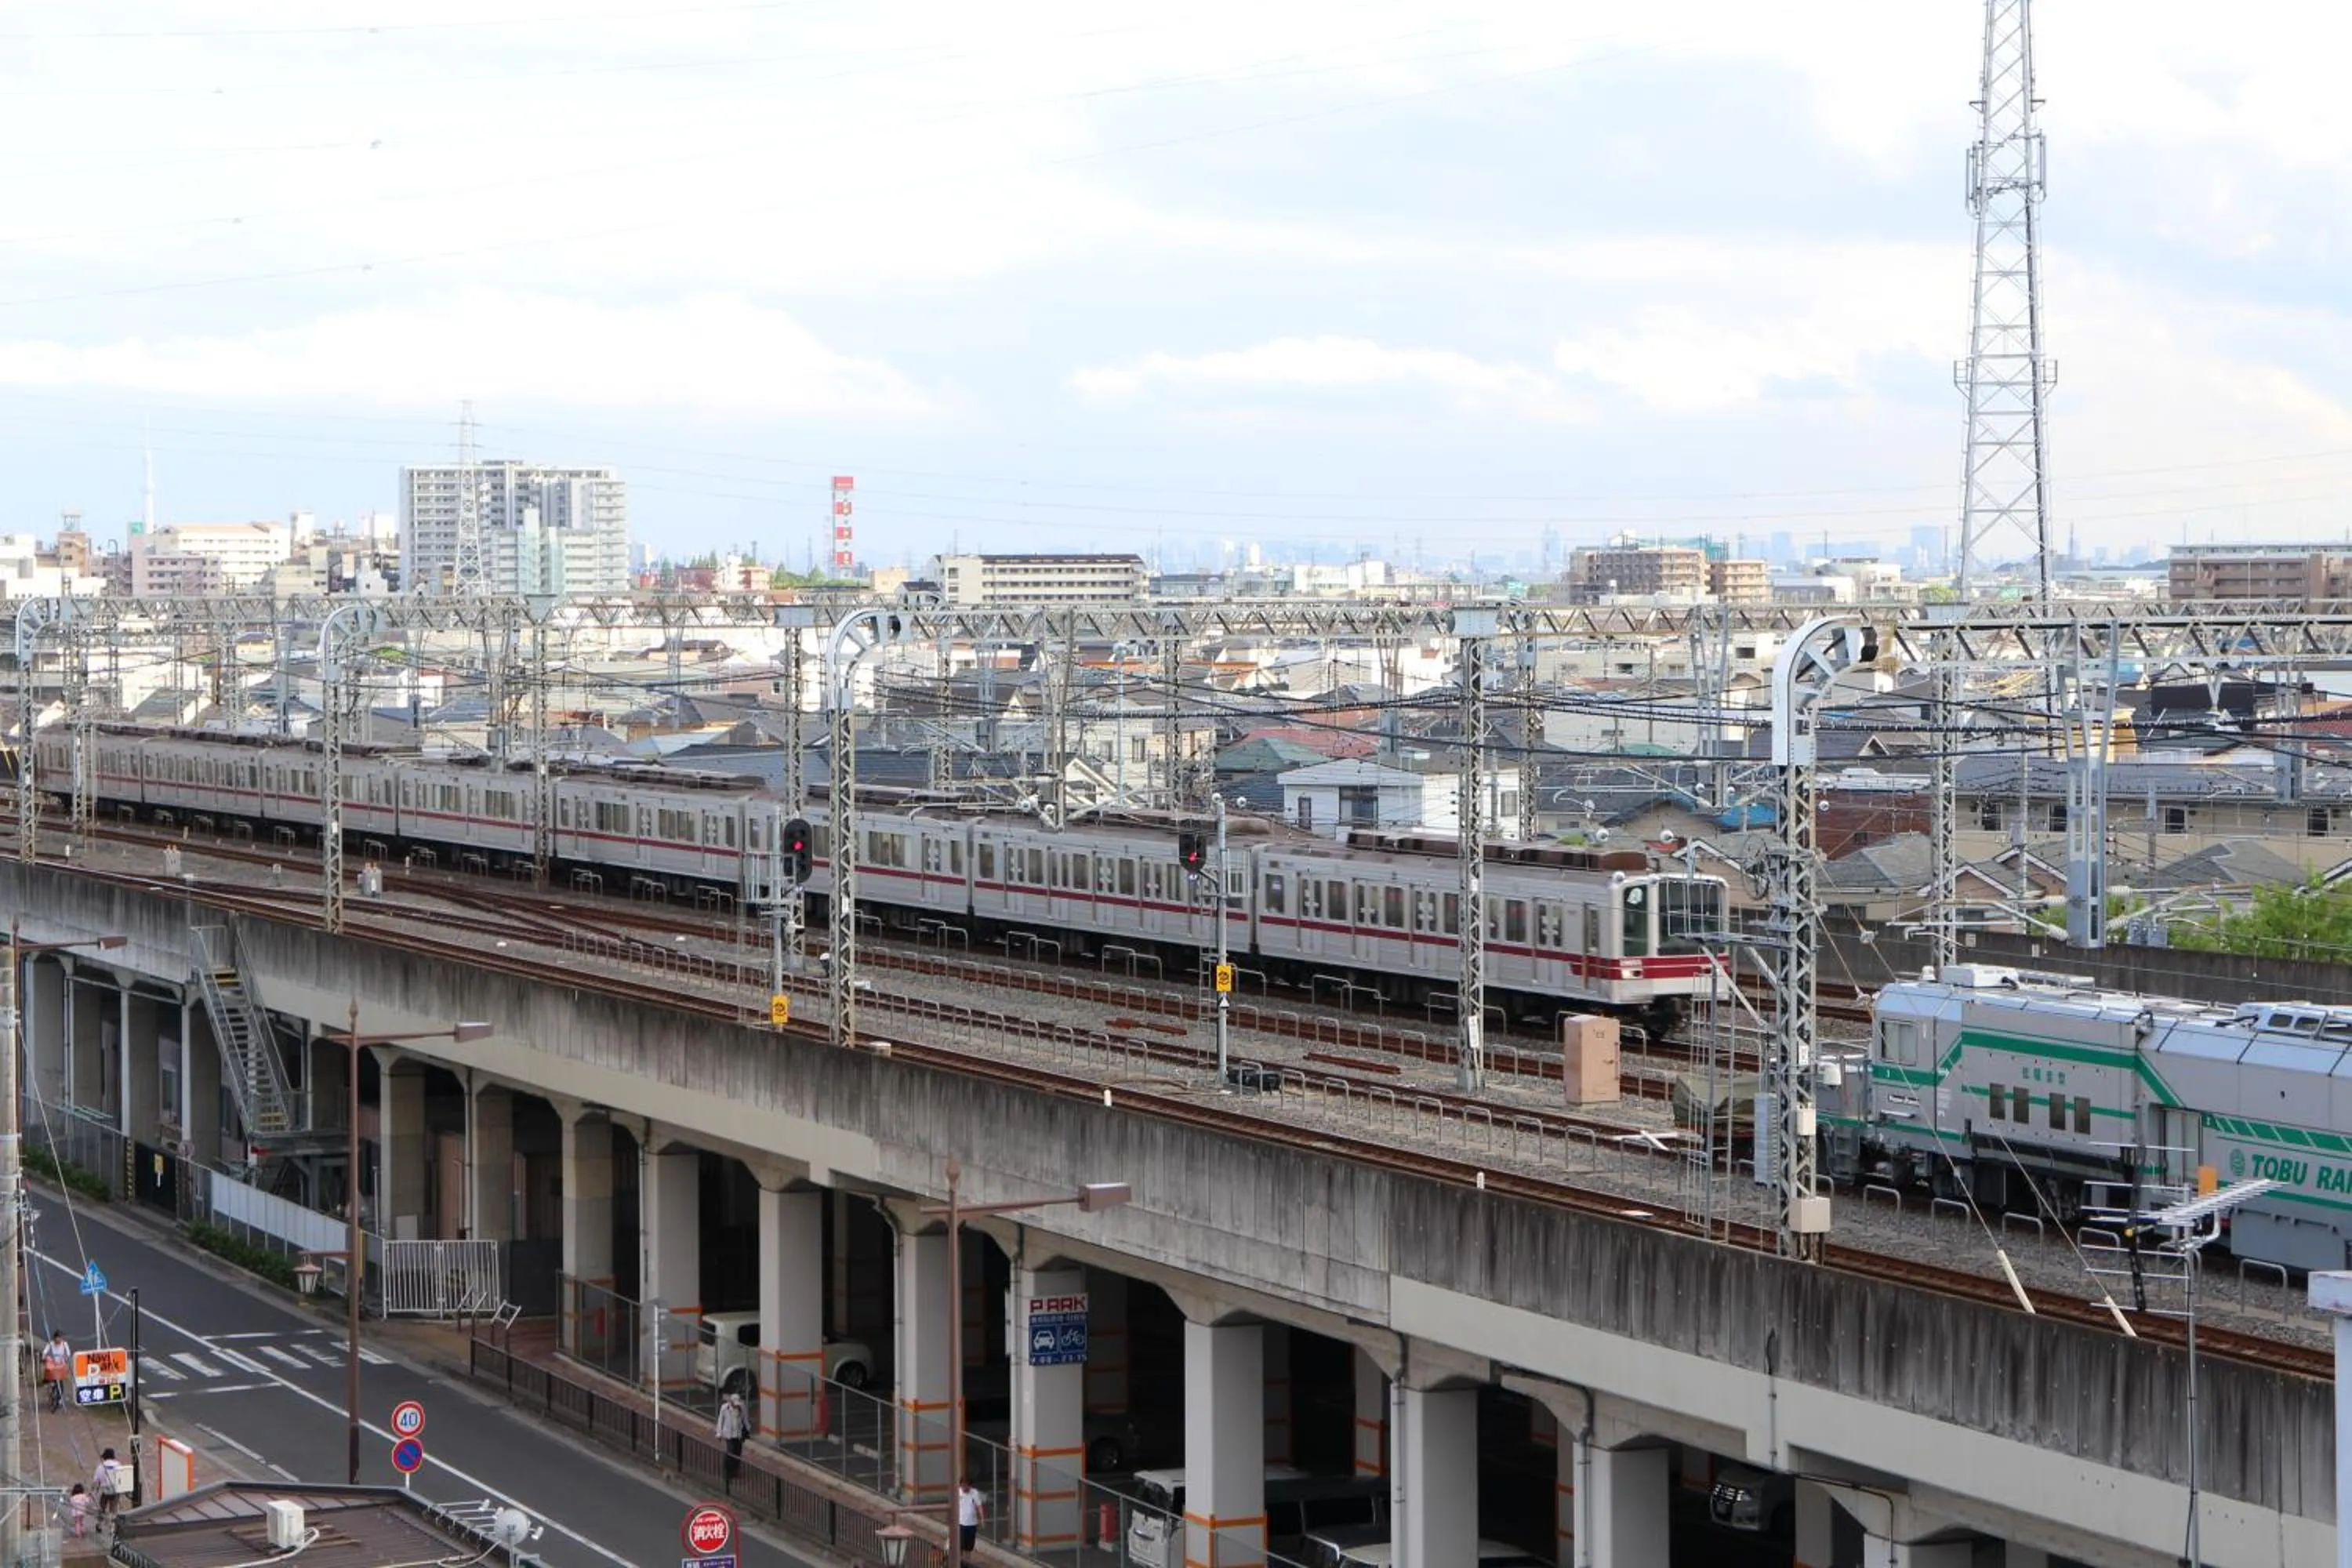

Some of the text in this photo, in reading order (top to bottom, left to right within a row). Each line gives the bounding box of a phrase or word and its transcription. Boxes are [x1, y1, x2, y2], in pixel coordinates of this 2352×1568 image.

[2252, 1153, 2308, 1185] TOBU
[1030, 1296, 1086, 1313] PARK
[87, 1352, 111, 1365] Navi
[79, 1388, 103, 1402] 空車
[111, 1385, 122, 1399] P
[401, 1412, 418, 1426] 40
[693, 1523, 725, 1542] 消火栓
